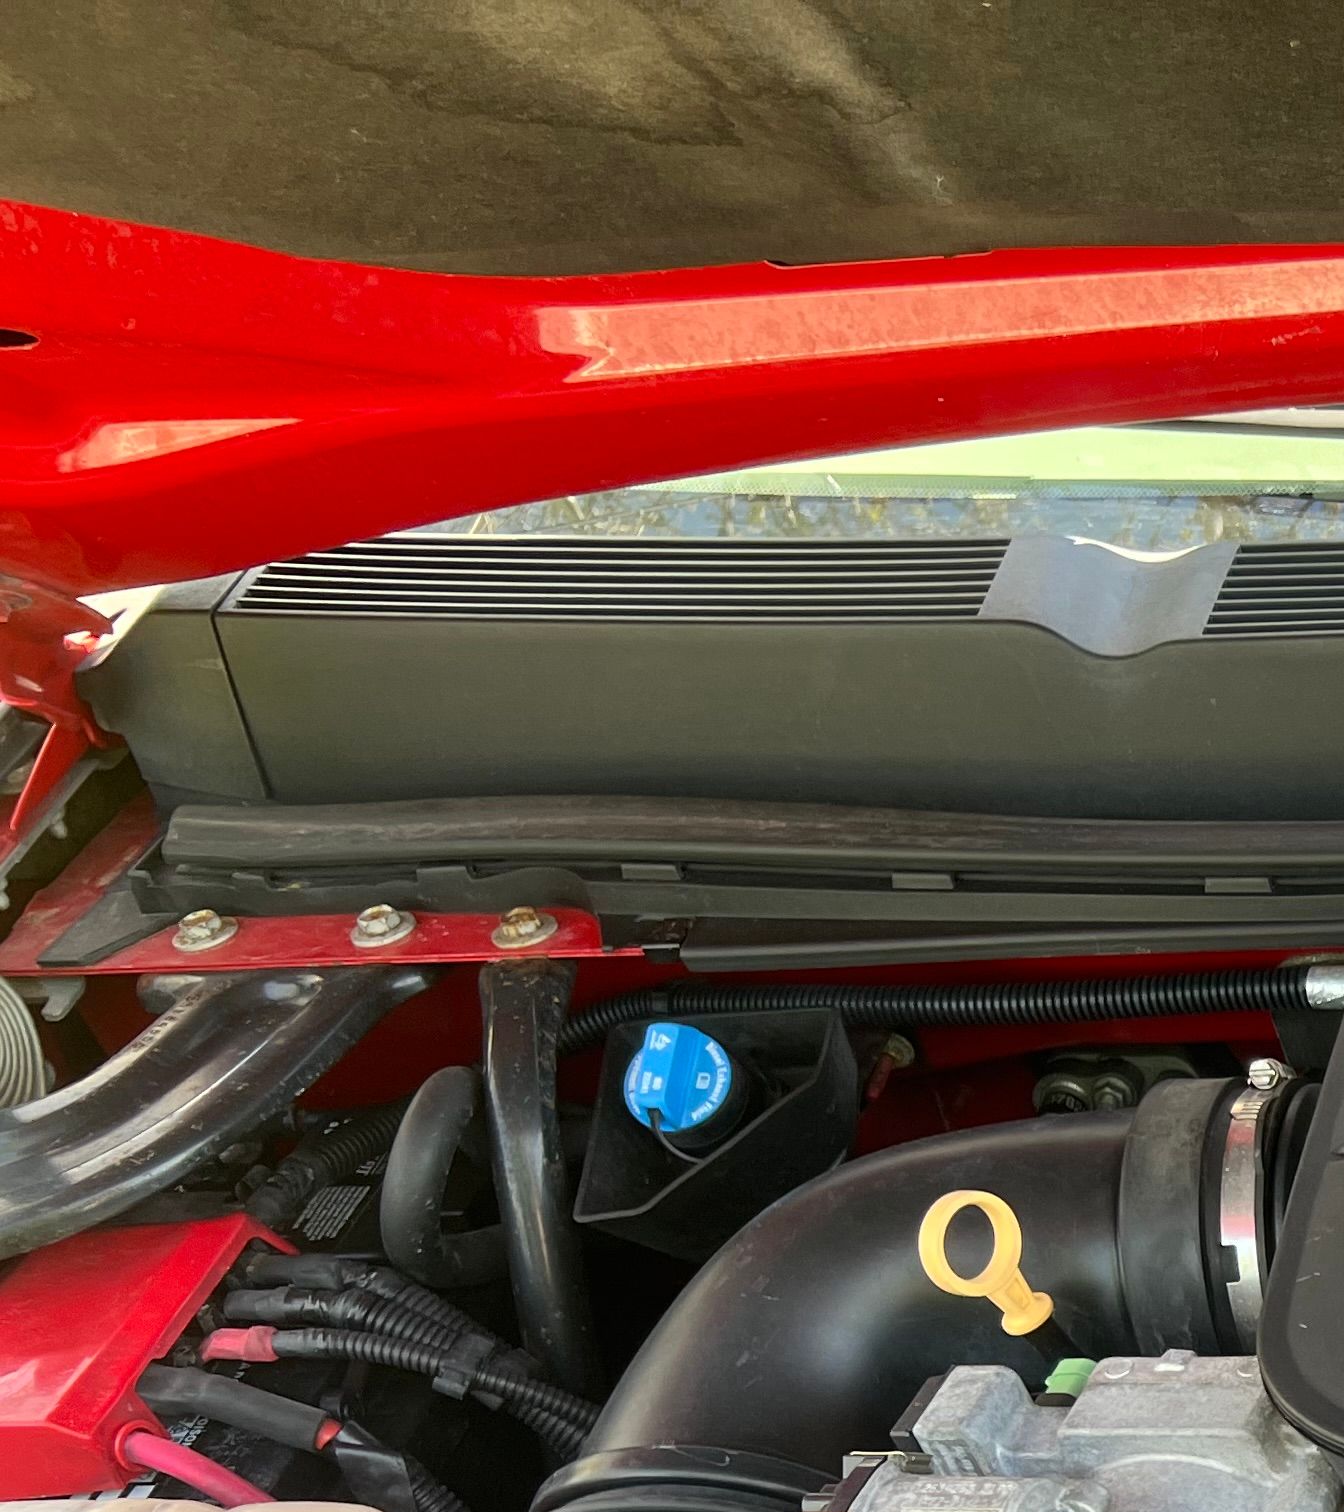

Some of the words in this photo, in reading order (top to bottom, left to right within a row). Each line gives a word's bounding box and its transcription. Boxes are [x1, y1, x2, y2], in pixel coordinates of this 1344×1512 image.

[705, 1041, 725, 1068] Diesel
[710, 1067, 728, 1104] Exhaust
[691, 1100, 713, 1121] Fluid
